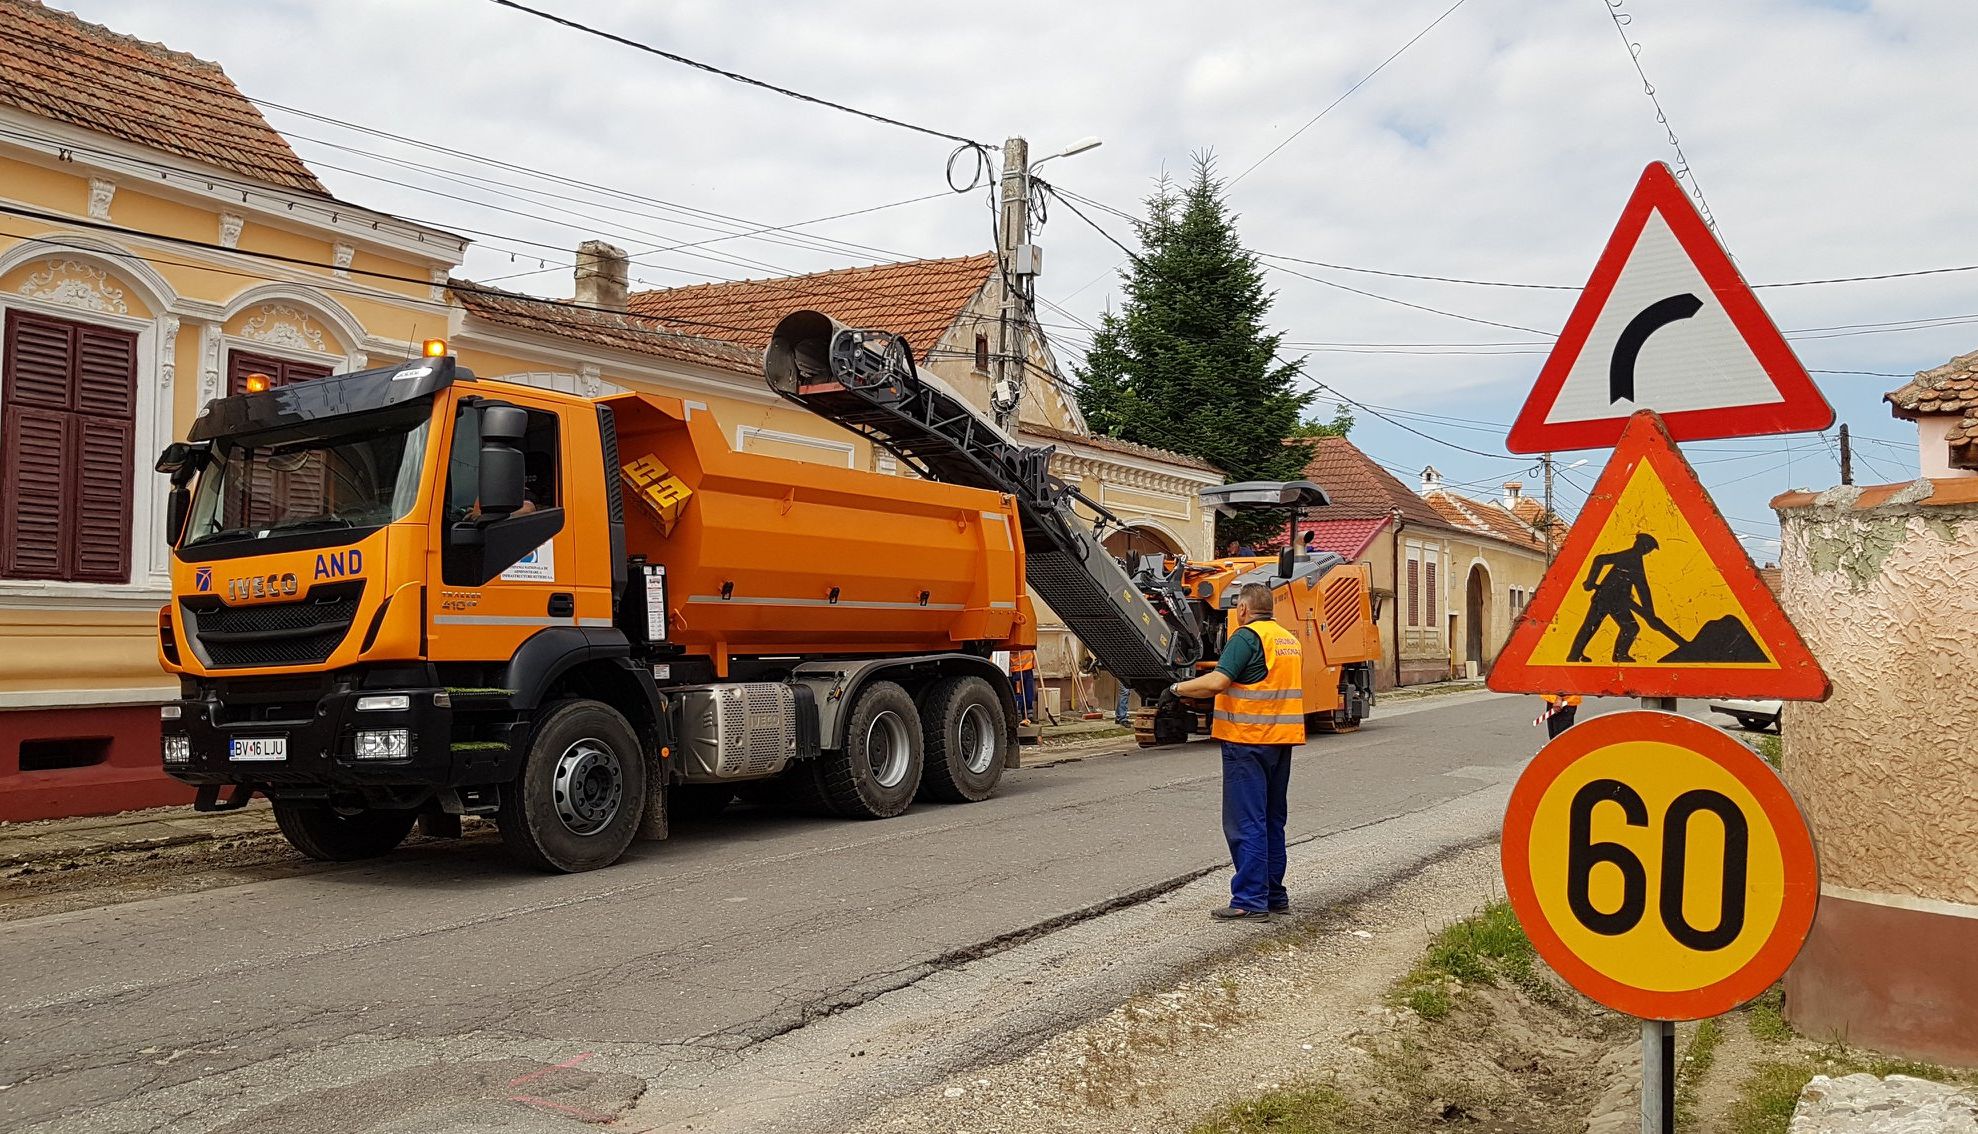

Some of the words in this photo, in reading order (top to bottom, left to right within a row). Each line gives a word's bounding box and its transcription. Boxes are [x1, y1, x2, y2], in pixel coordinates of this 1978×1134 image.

[314, 549, 363, 580] AND
[228, 573, 298, 601] IVECO
[441, 591, 482, 599] TRAKKER
[749, 714, 780, 728] IVECO
[235, 741, 249, 756] BV
[252, 741, 262, 756] 16
[264, 740, 283, 755] LJU
[1567, 778, 1749, 952] 60
